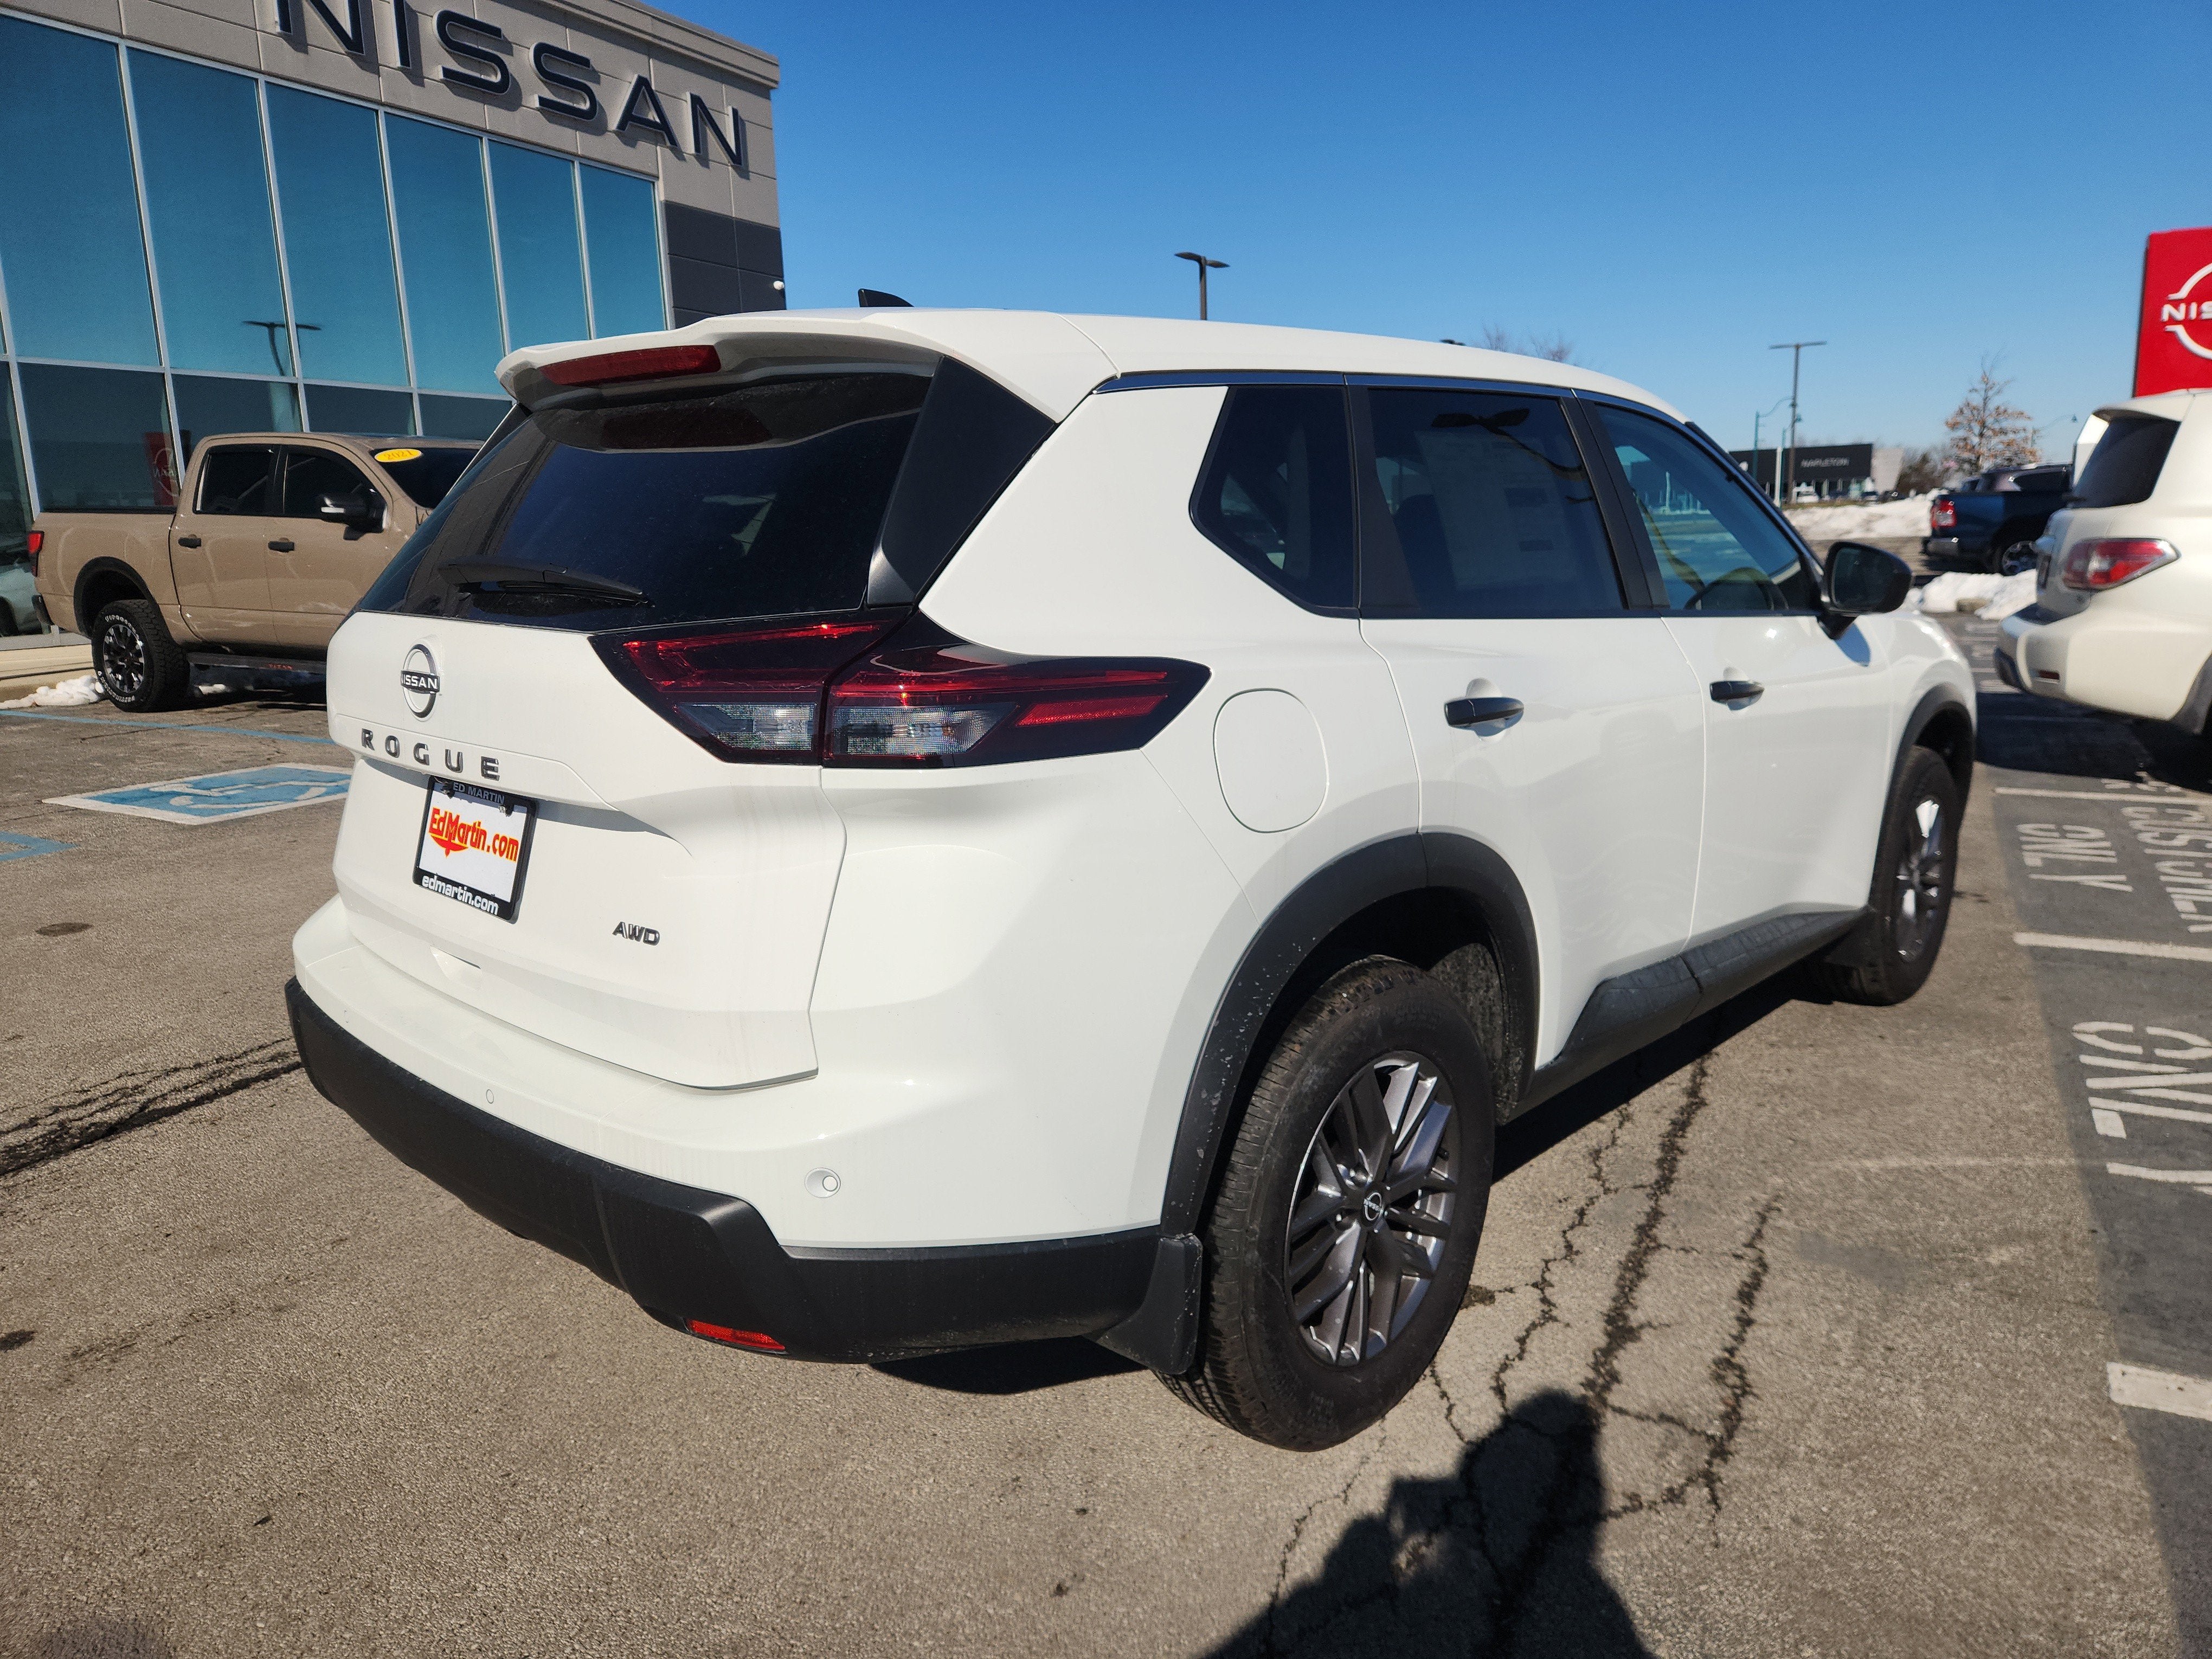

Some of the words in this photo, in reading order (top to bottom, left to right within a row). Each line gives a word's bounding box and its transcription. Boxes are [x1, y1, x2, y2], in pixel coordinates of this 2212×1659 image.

[401, 673, 438, 690] NISSAN
[362, 728, 500, 781] ROGUE
[453, 782, 466, 793] ED
[468, 786, 505, 805] MARTIN
[2017, 823, 2133, 893] ONLY
[422, 875, 499, 915] edmartin.com
[612, 921, 660, 946] AWD
